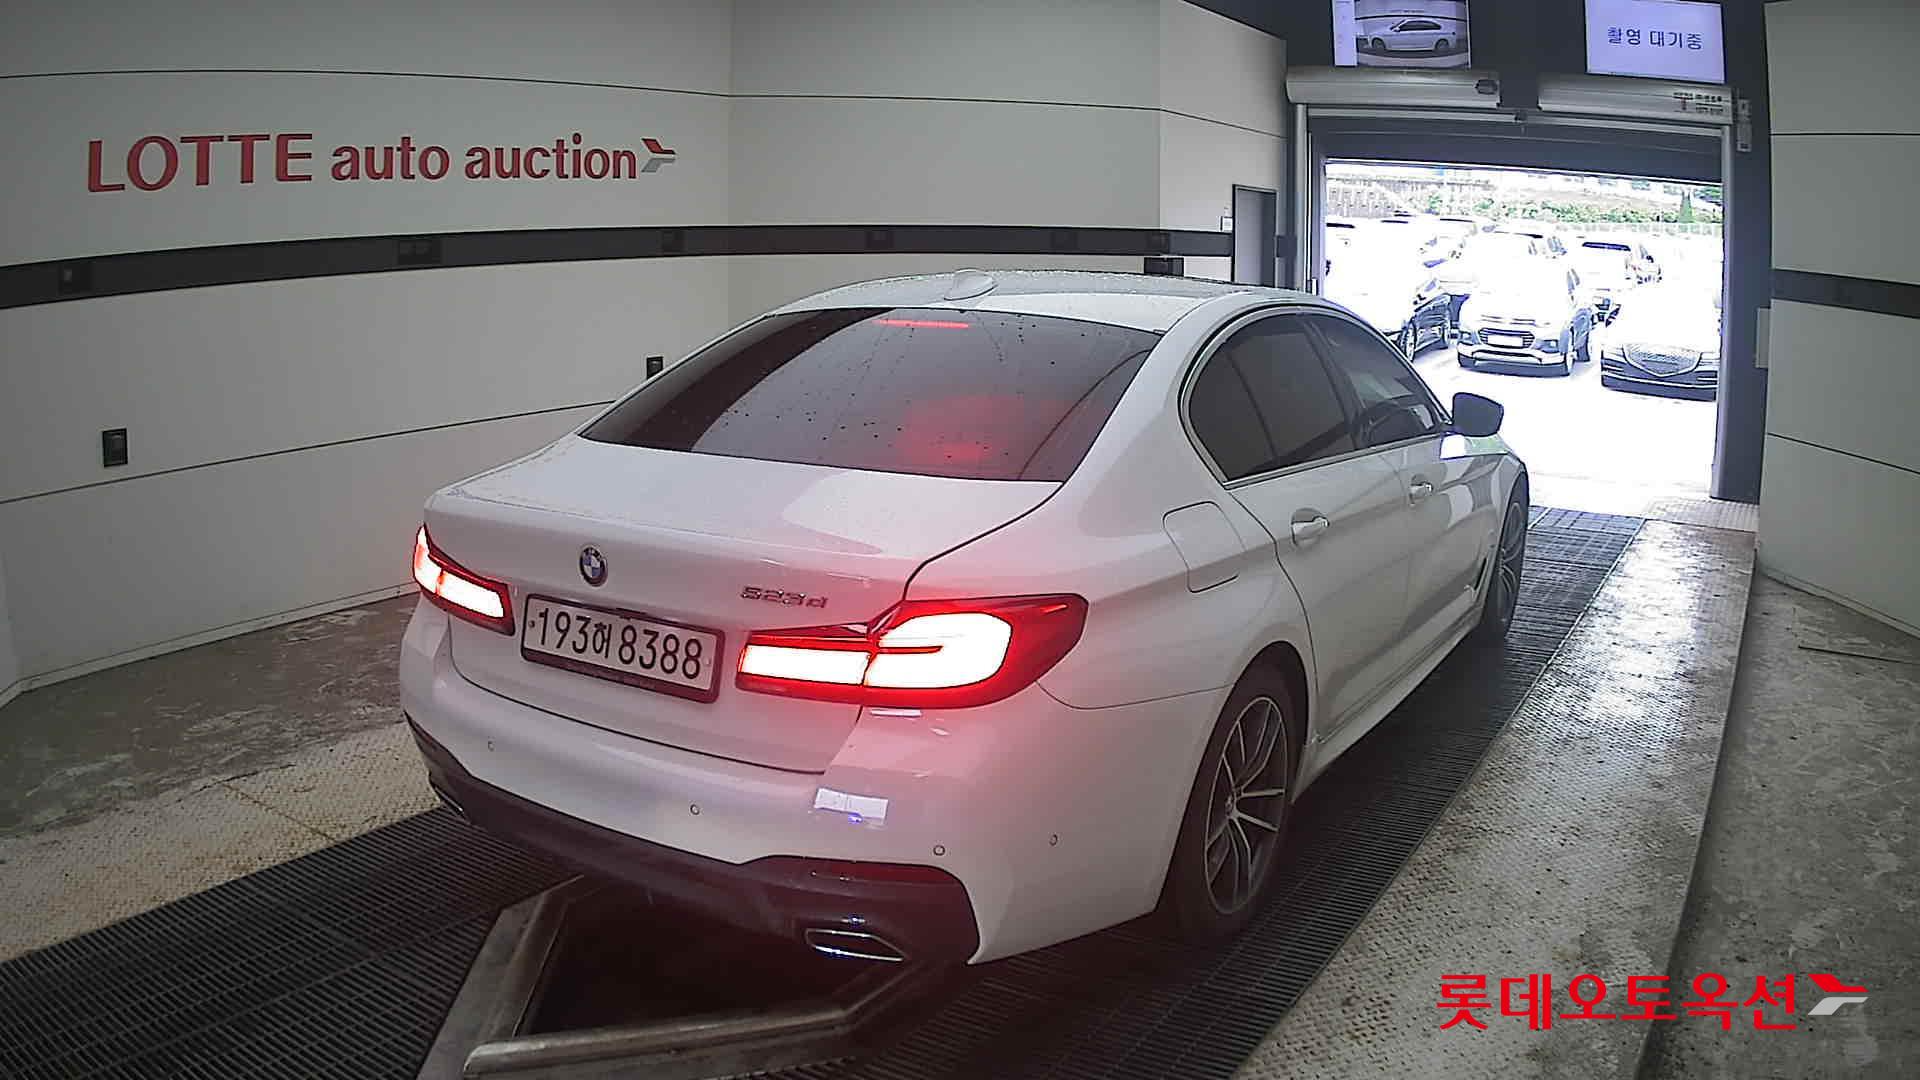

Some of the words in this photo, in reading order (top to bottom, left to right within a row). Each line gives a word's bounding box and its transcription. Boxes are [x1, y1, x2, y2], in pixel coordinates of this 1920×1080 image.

[88, 133, 312, 192] LOTTE
[331, 136, 450, 181] auto
[464, 132, 638, 179] auction
